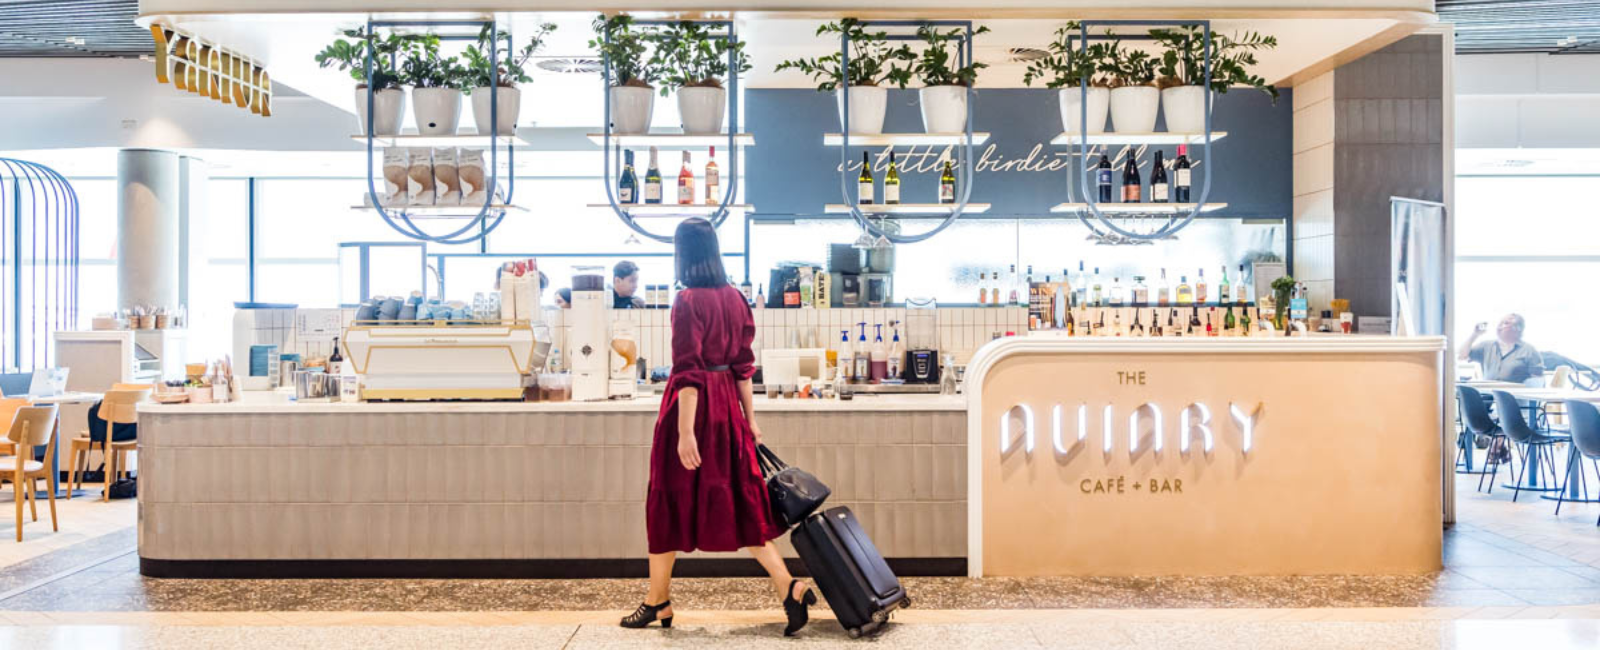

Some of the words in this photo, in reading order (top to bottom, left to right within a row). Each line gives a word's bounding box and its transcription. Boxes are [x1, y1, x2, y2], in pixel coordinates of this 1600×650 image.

[975, 143, 1068, 173] birdie
[1055, 144, 1148, 173] tld
[1162, 157, 1201, 171] m
[1117, 371, 1146, 385] THE
[1001, 401, 1263, 455] AVIARY
[1080, 476, 1125, 493] CAFÉ
[1132, 481, 1142, 491] +
[1150, 479, 1182, 493] BAR
